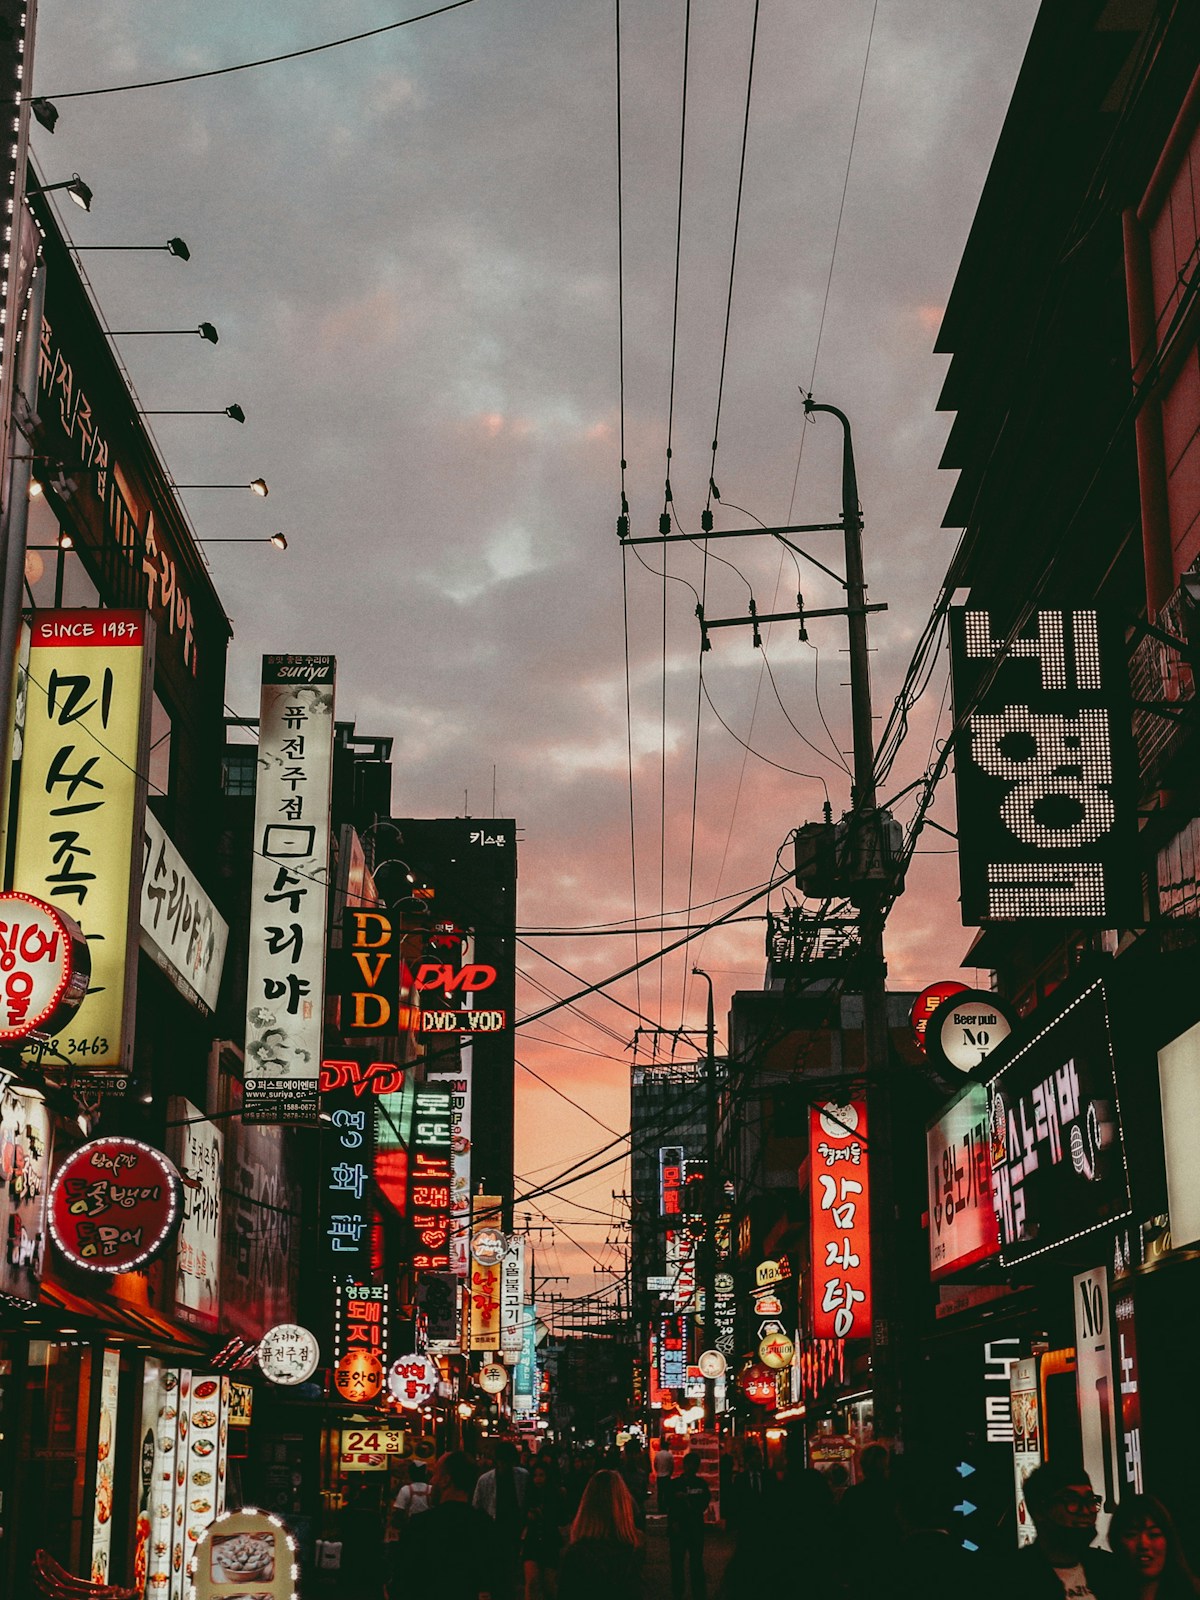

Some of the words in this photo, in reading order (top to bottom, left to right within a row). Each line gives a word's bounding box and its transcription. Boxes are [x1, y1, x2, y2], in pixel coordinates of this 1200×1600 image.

[41, 622, 95, 637] SINCE
[102, 622, 139, 638] 1987
[277, 664, 330, 682] suriya
[45, 667, 114, 992] 미쓰족
[351, 912, 392, 1028] DVD
[414, 963, 497, 992] DVD
[954, 1013, 976, 1025] Beer
[978, 1013, 997, 1026] pub
[68, 1036, 109, 1056] 3463
[320, 1060, 403, 1097] DVD
[818, 1174, 866, 1338] 감자탕
[759, 1269, 780, 1281] Max
[345, 1286, 384, 1299] 영등포
[262, 1346, 309, 1362] 퓨전주점
[348, 1432, 381, 1452] 24
